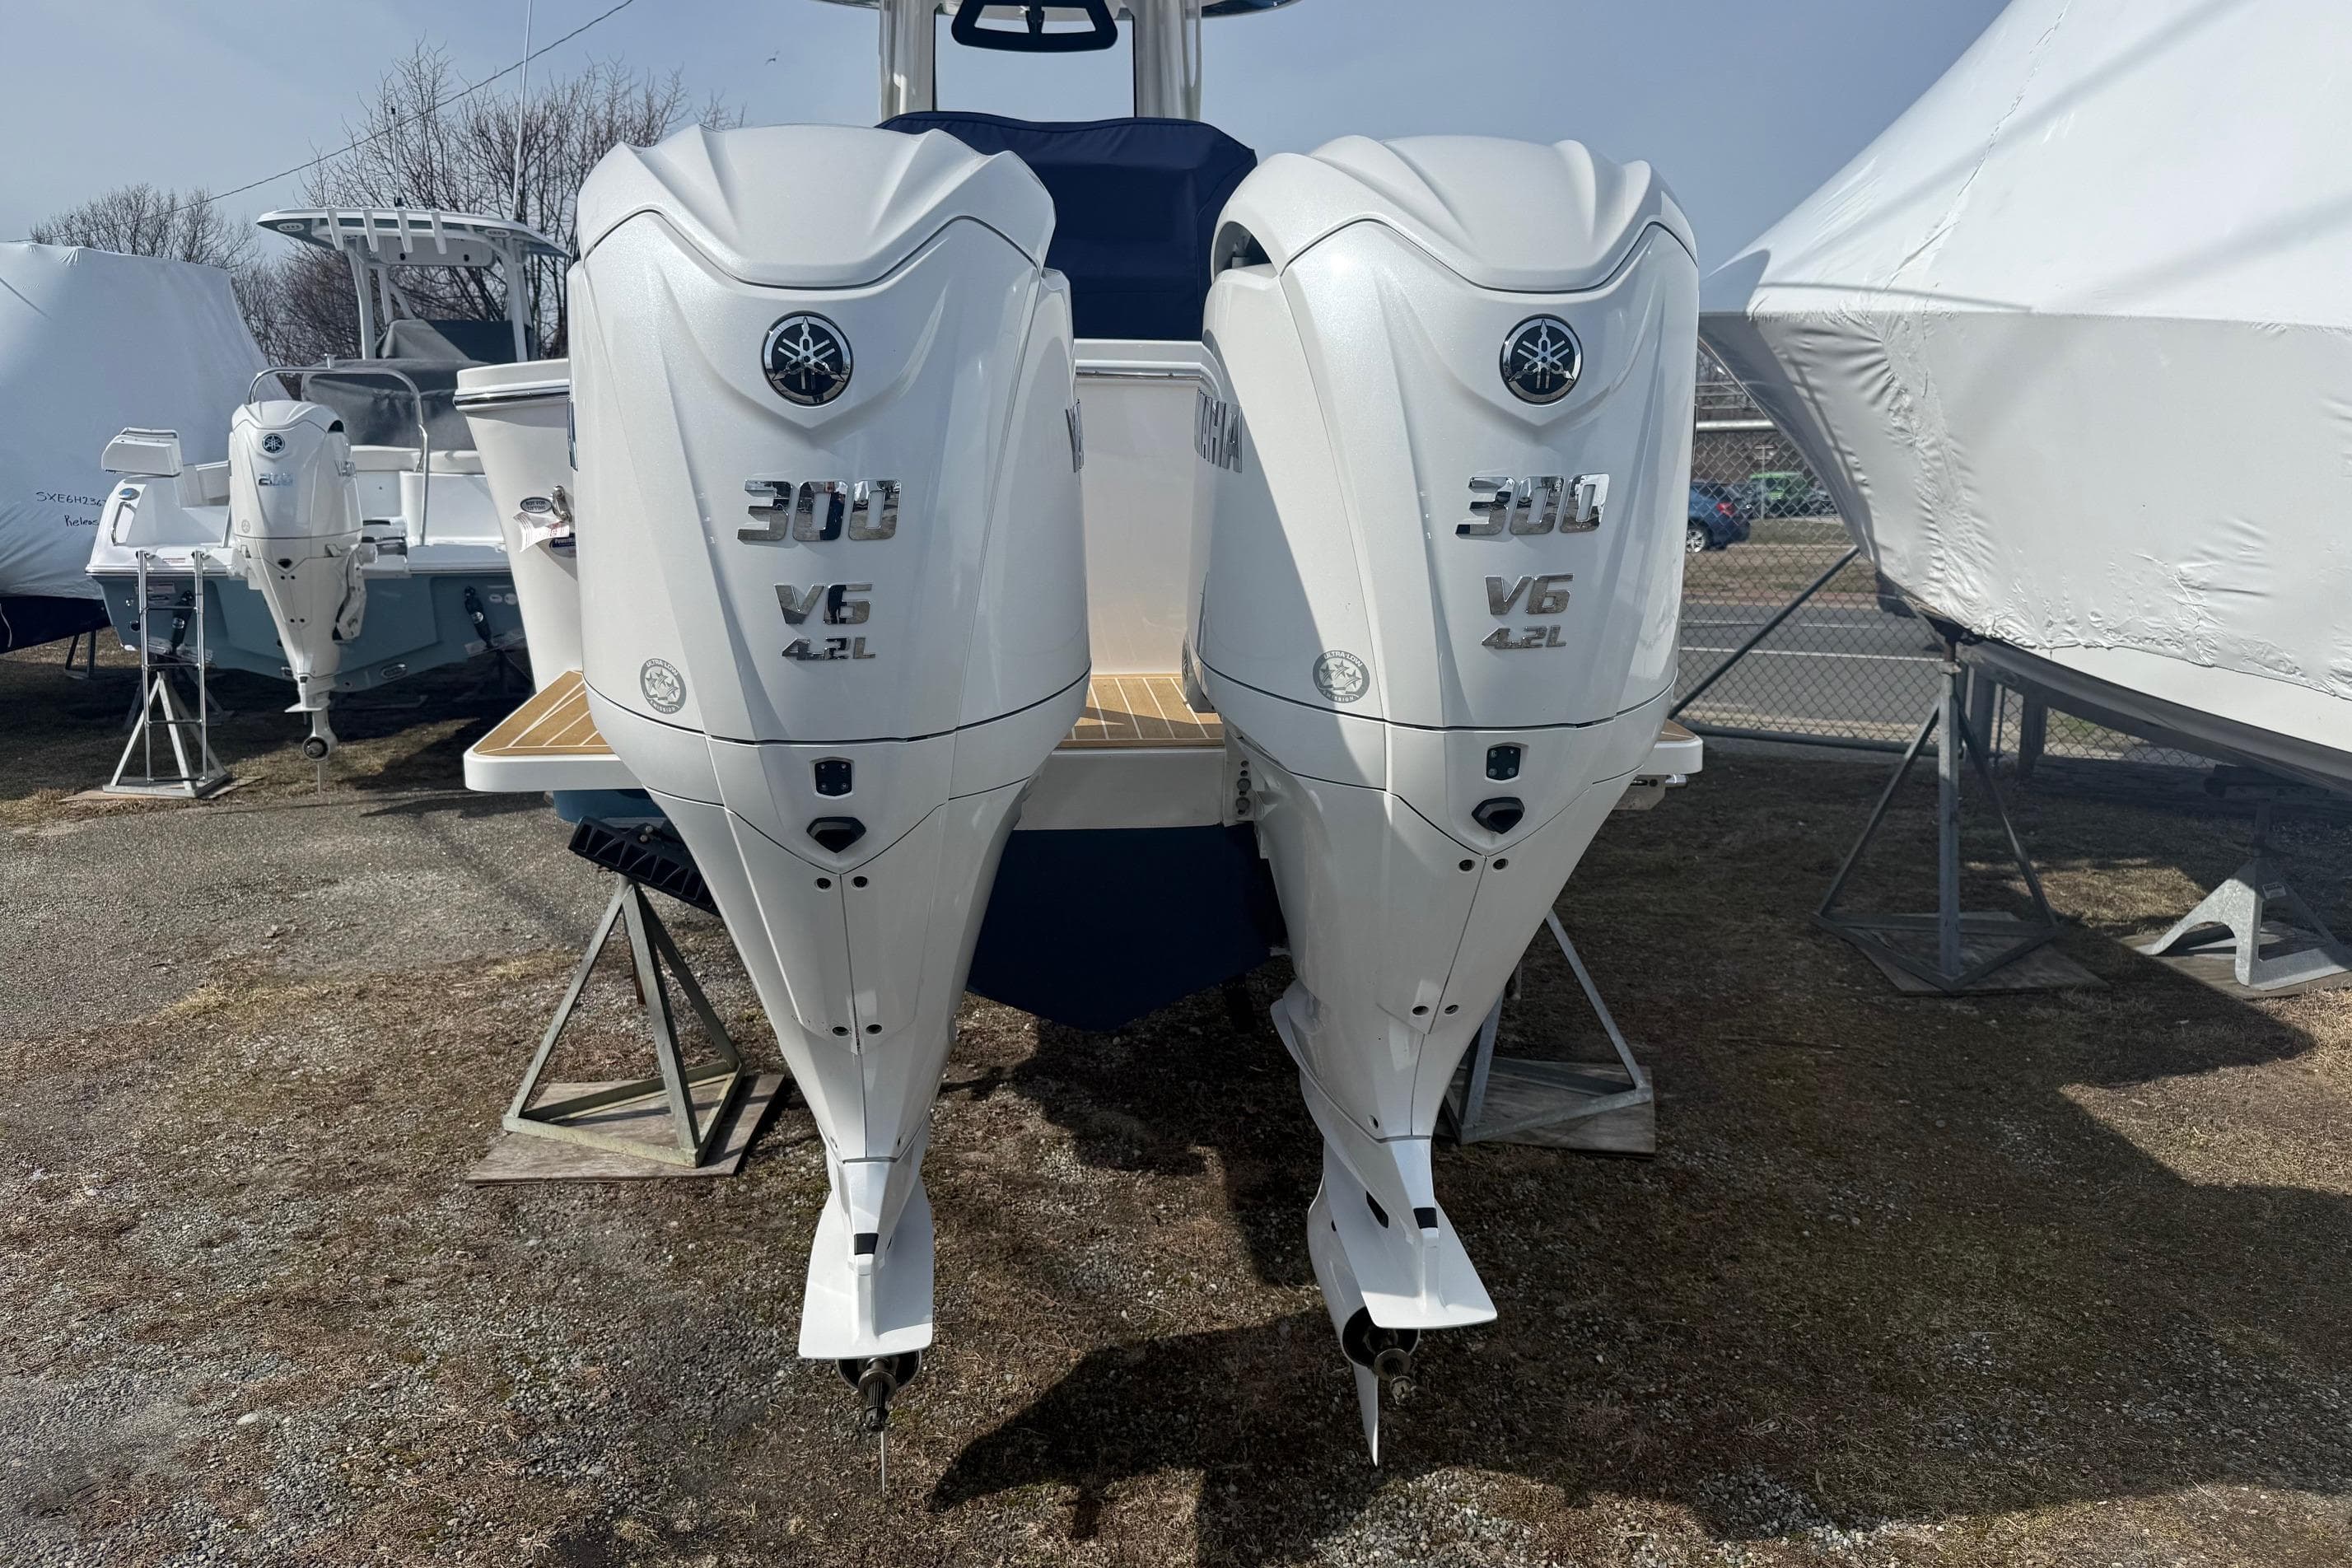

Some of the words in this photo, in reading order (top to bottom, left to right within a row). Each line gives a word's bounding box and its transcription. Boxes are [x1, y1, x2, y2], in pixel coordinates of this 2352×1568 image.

[737, 479, 902, 542] 300
[1454, 473, 1610, 535] 300
[64, 515, 99, 527] Releas
[773, 584, 873, 625] V6
[1485, 573, 1574, 615] V6
[782, 636, 876, 661] 4.2L
[1482, 625, 1567, 650] 4.2L
[646, 659, 664, 667] ULTRA
[664, 662, 679, 676] LOW
[1323, 651, 1346, 660] ULTRA
[1346, 653, 1363, 667] LOW
[650, 699, 676, 712] EMISSION
[1323, 690, 1355, 702] EMISSION
